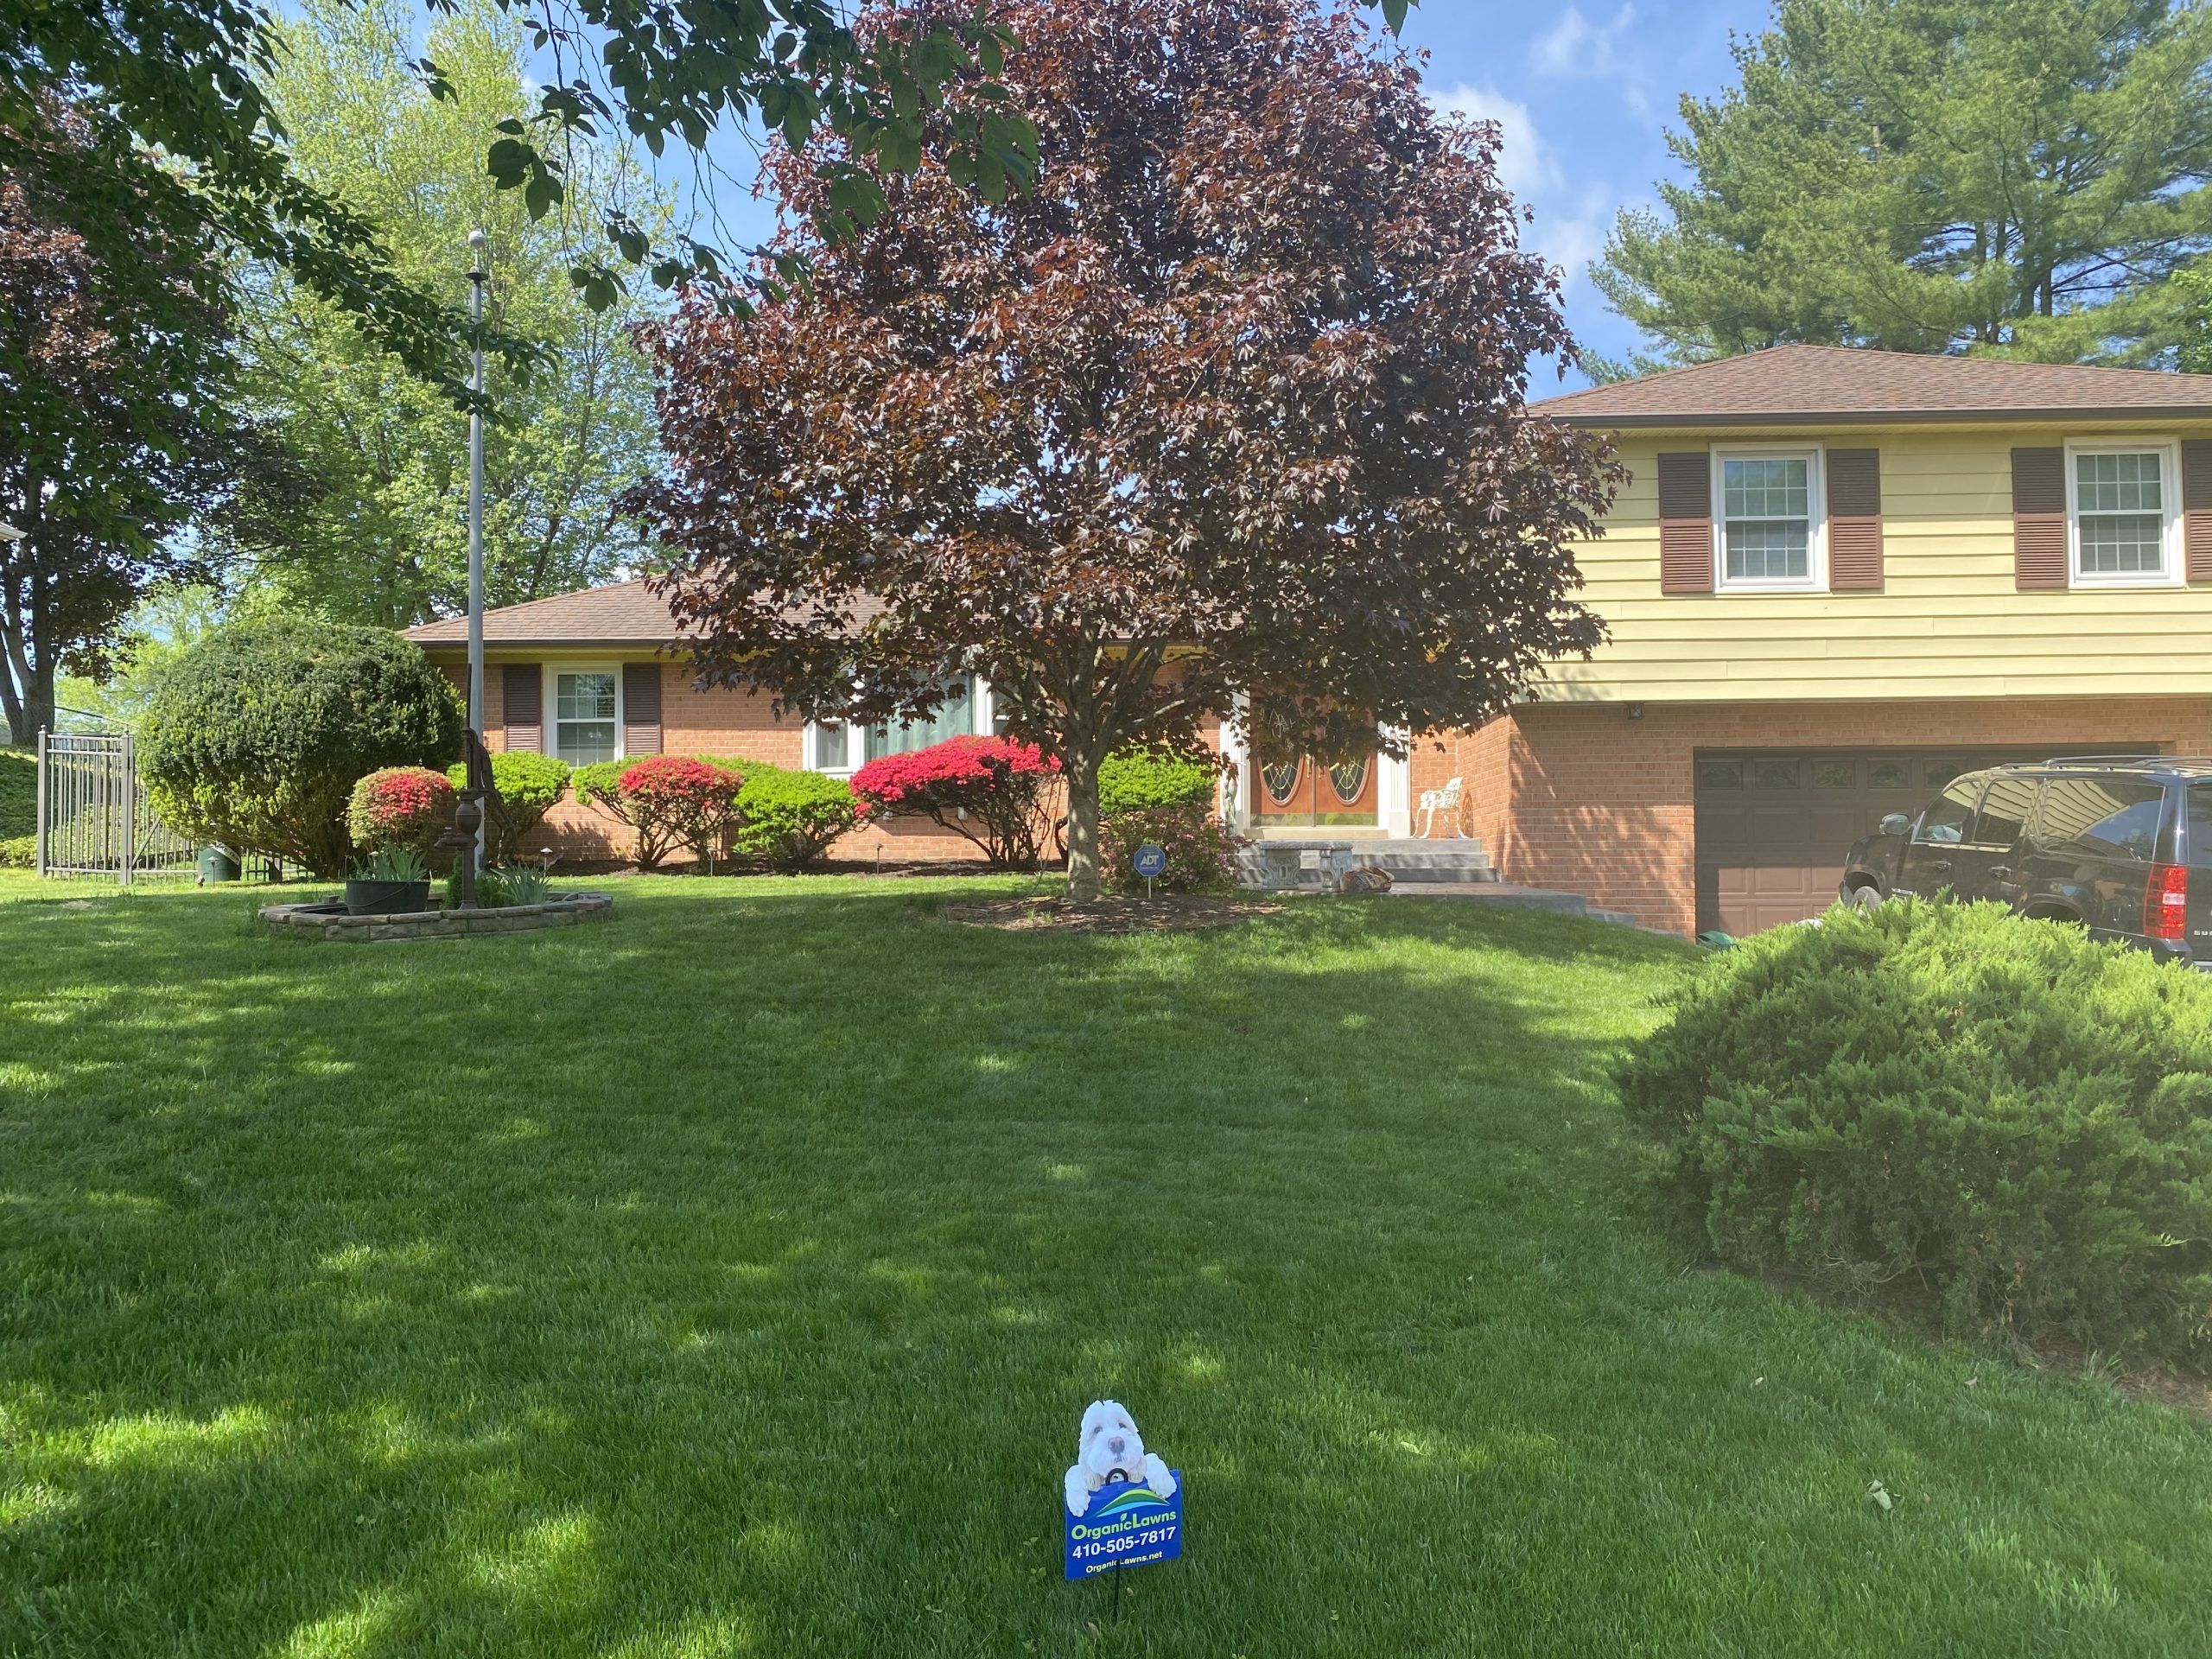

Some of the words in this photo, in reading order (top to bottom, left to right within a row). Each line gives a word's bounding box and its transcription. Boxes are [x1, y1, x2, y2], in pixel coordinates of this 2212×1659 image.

[1141, 855, 1159, 865] ADT
[1071, 1511, 1176, 1540] OrganicLawns
[1072, 1526, 1176, 1558] 410-505-7817
